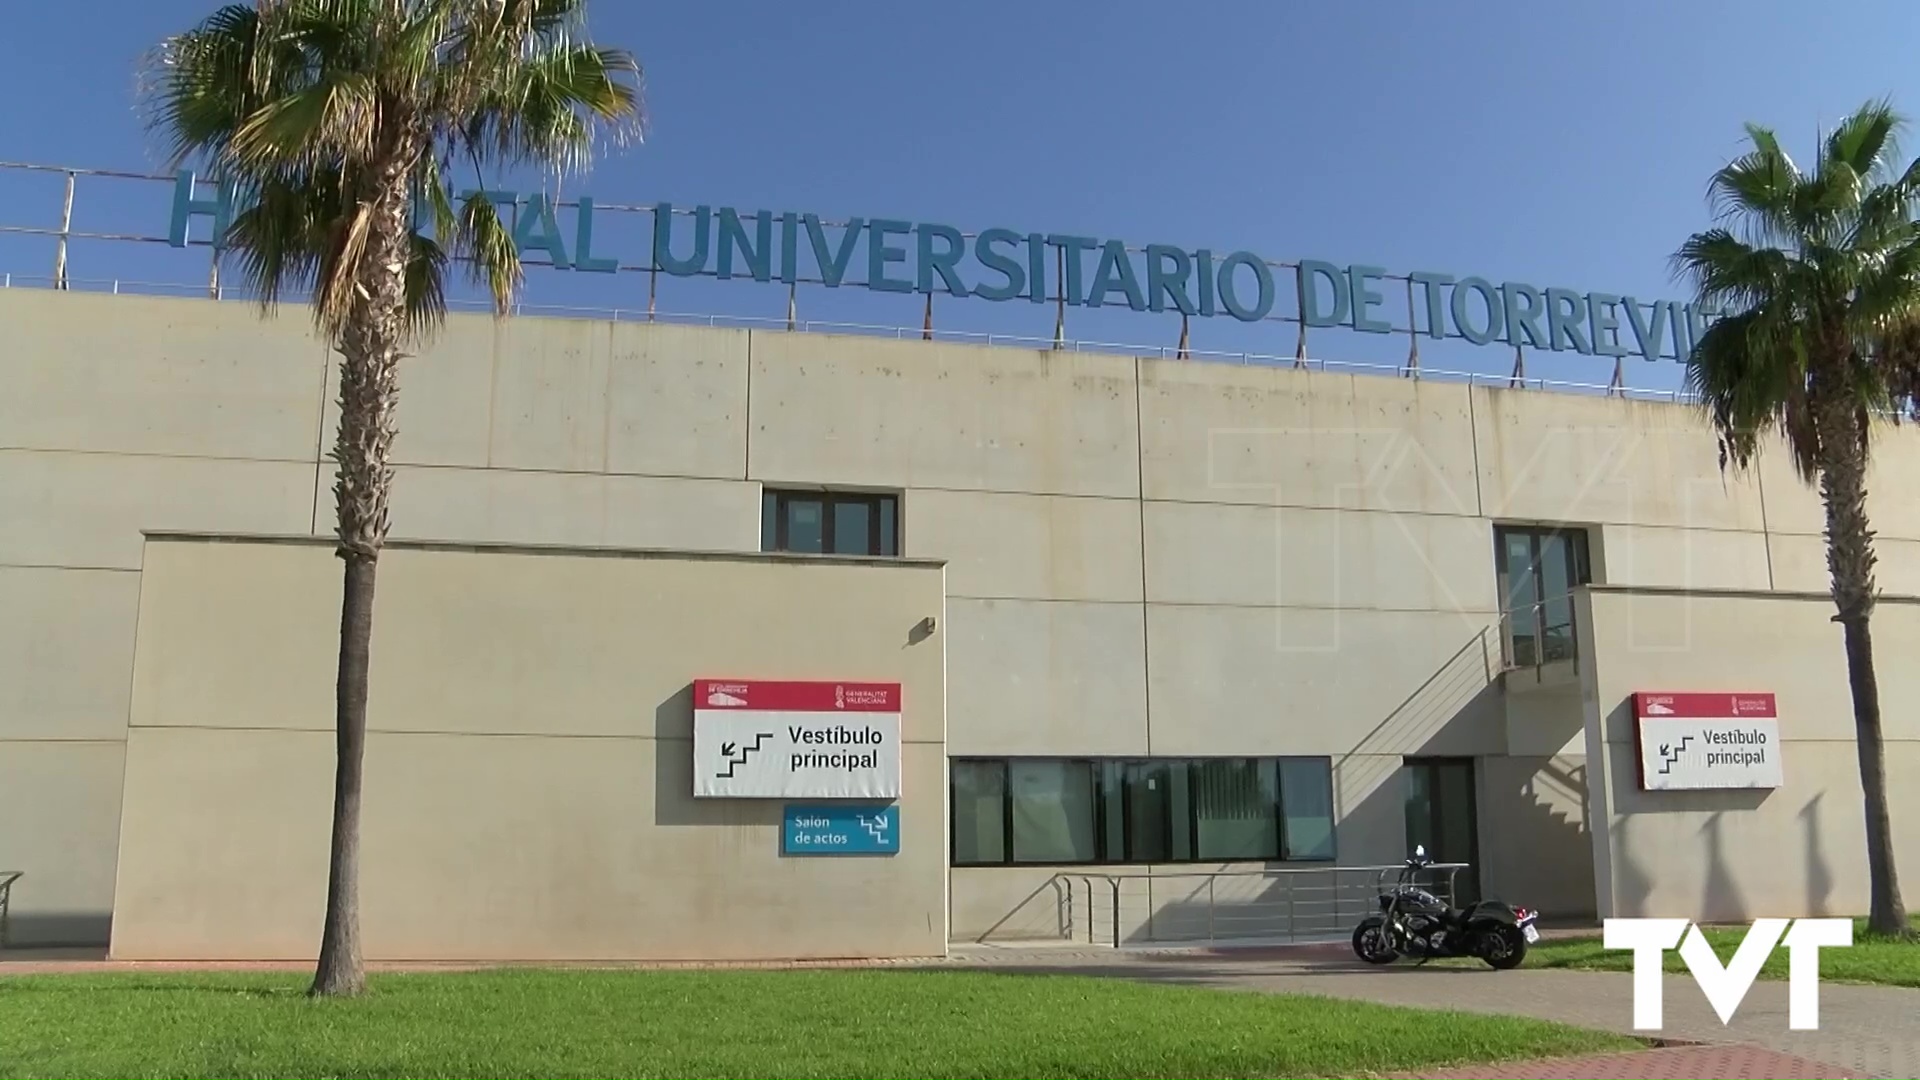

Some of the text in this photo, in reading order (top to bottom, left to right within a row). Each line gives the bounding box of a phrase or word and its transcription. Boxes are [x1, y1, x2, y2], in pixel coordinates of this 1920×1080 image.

[654, 202, 1275, 322] UNIVERSITARIO
[1299, 259, 1393, 334] DE
[1408, 271, 1737, 364] TORREVI
[788, 725, 883, 745] Vestíbulo
[1702, 729, 1767, 745] Vestíbulo
[790, 749, 878, 772] principal
[1707, 748, 1765, 768] principal
[794, 830, 848, 845] de actos
